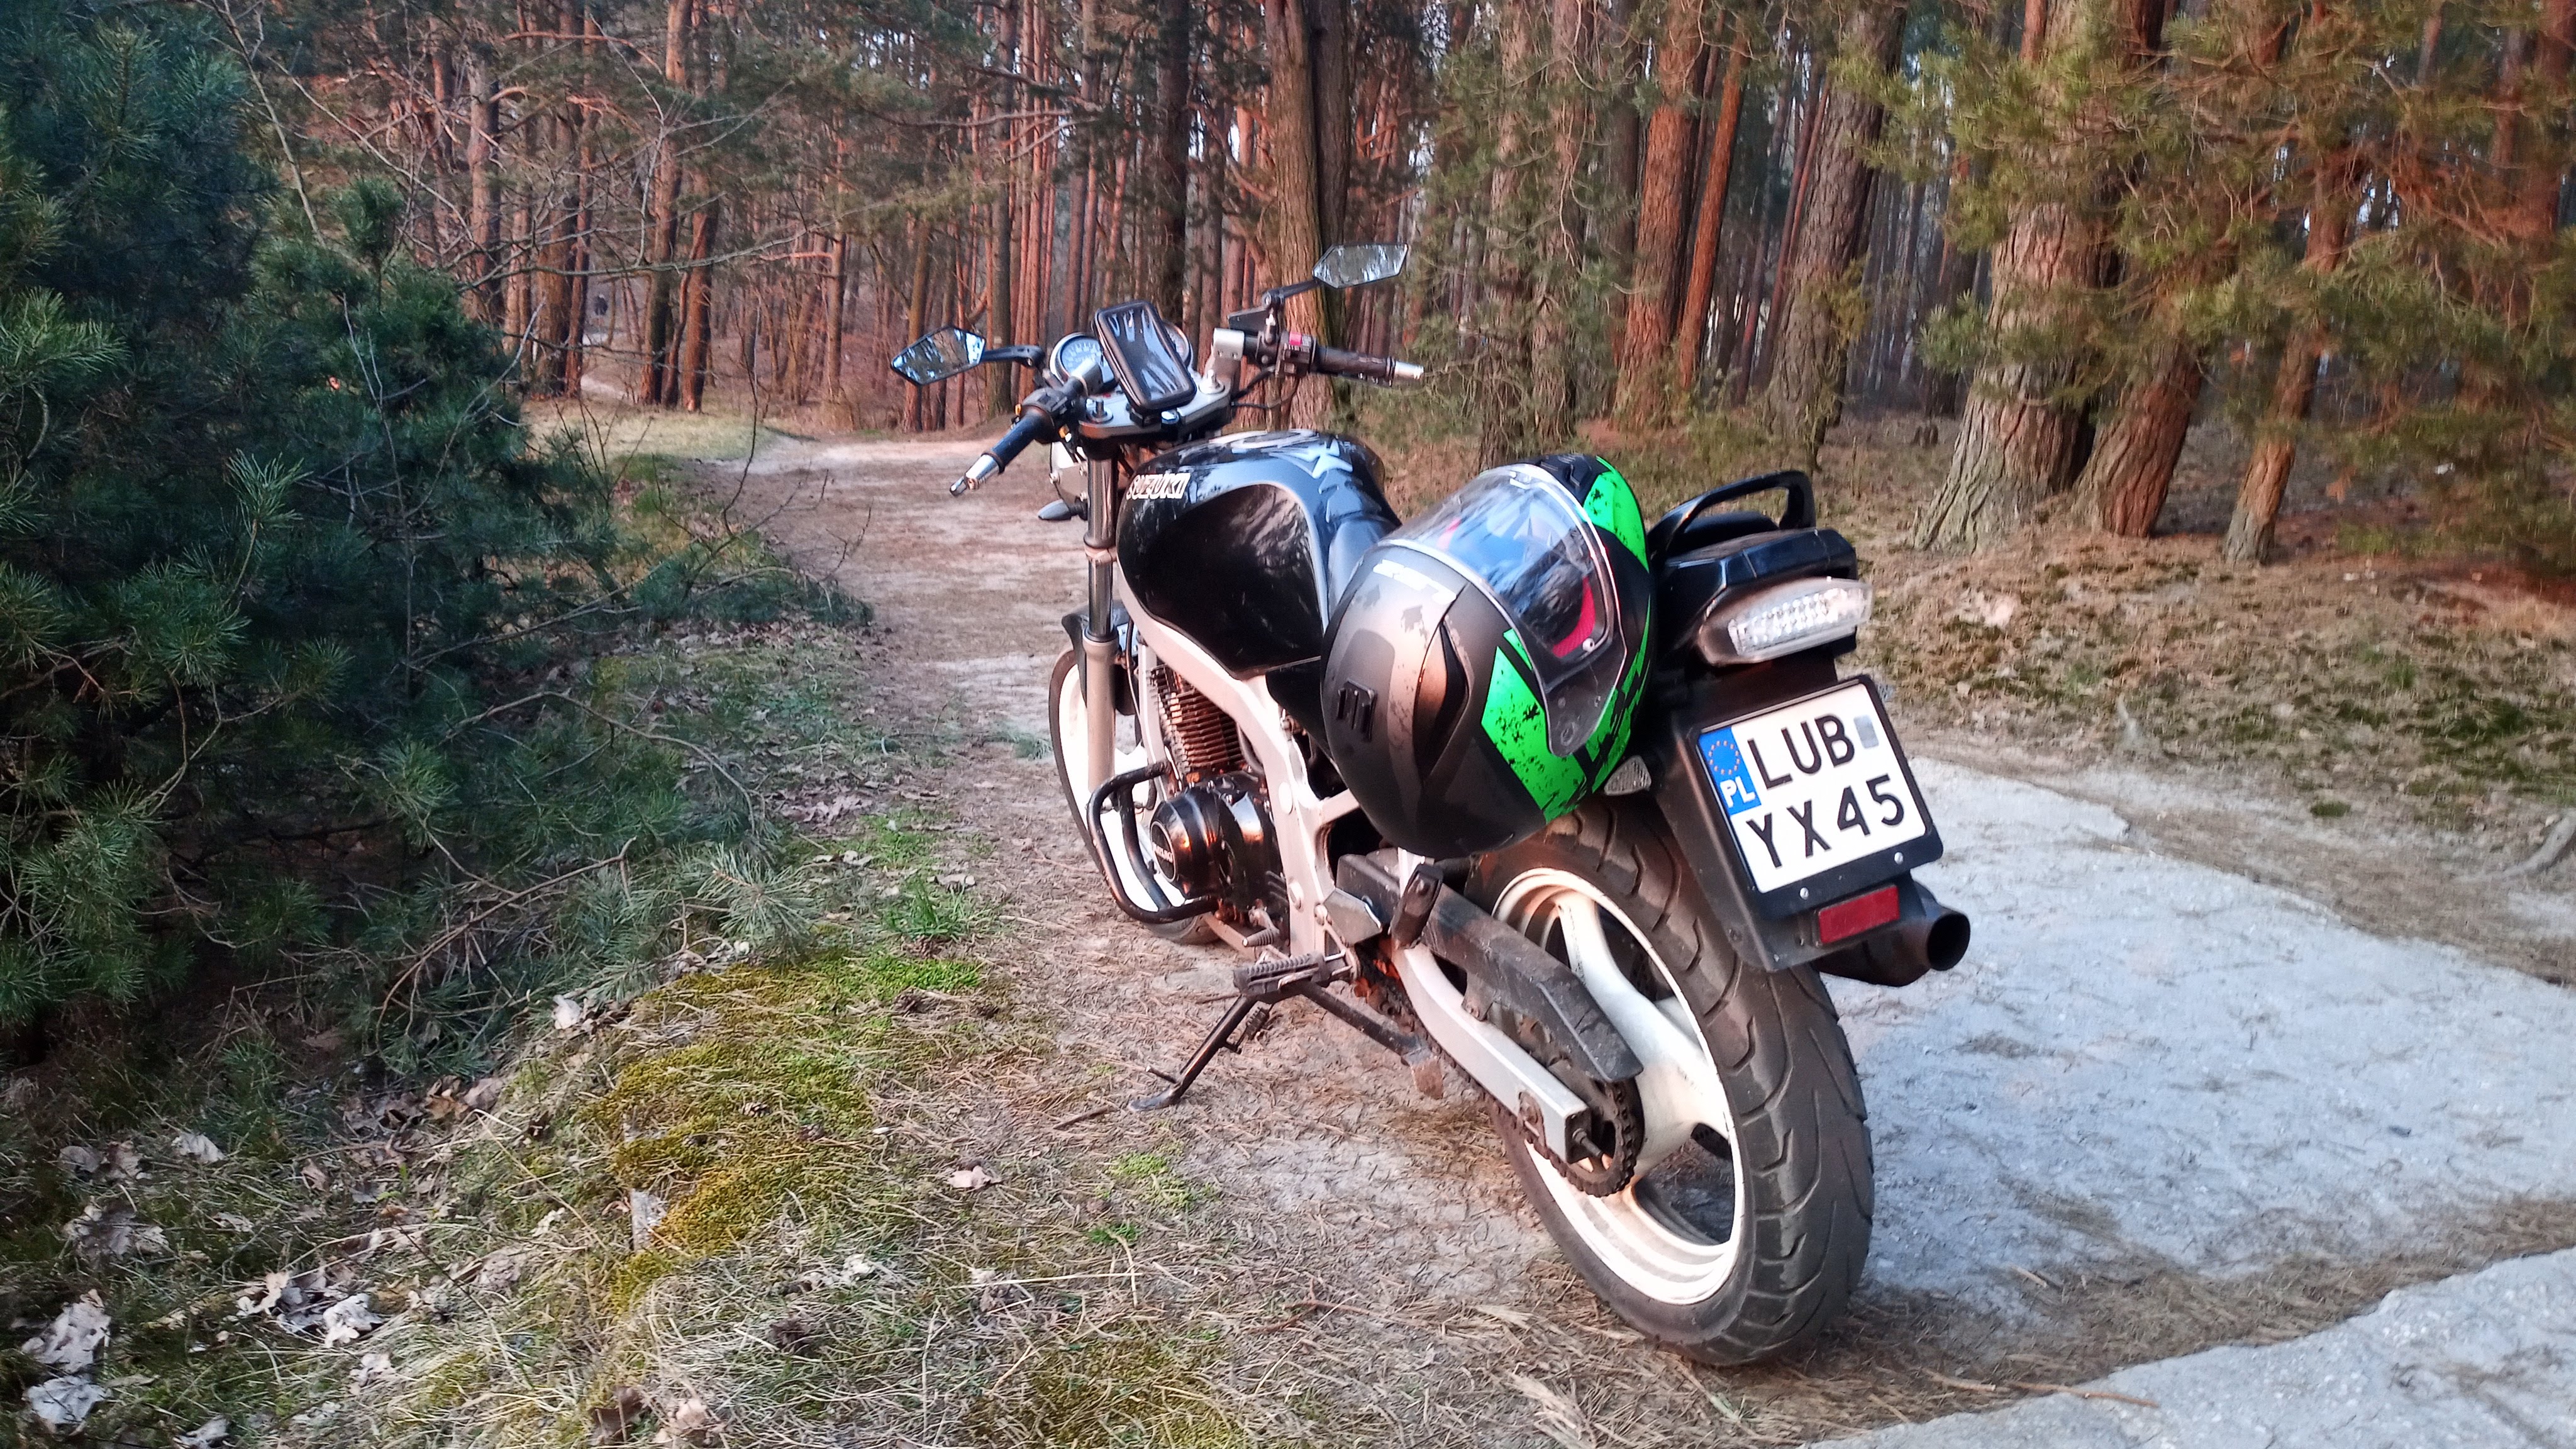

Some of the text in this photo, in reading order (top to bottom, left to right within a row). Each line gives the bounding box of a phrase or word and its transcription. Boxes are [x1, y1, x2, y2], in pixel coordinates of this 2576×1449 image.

[1126, 473, 1191, 500] SUZUKI
[1747, 715, 1855, 789] LUB
[1720, 776, 1755, 808] PL
[1746, 774, 1904, 868] YX45
